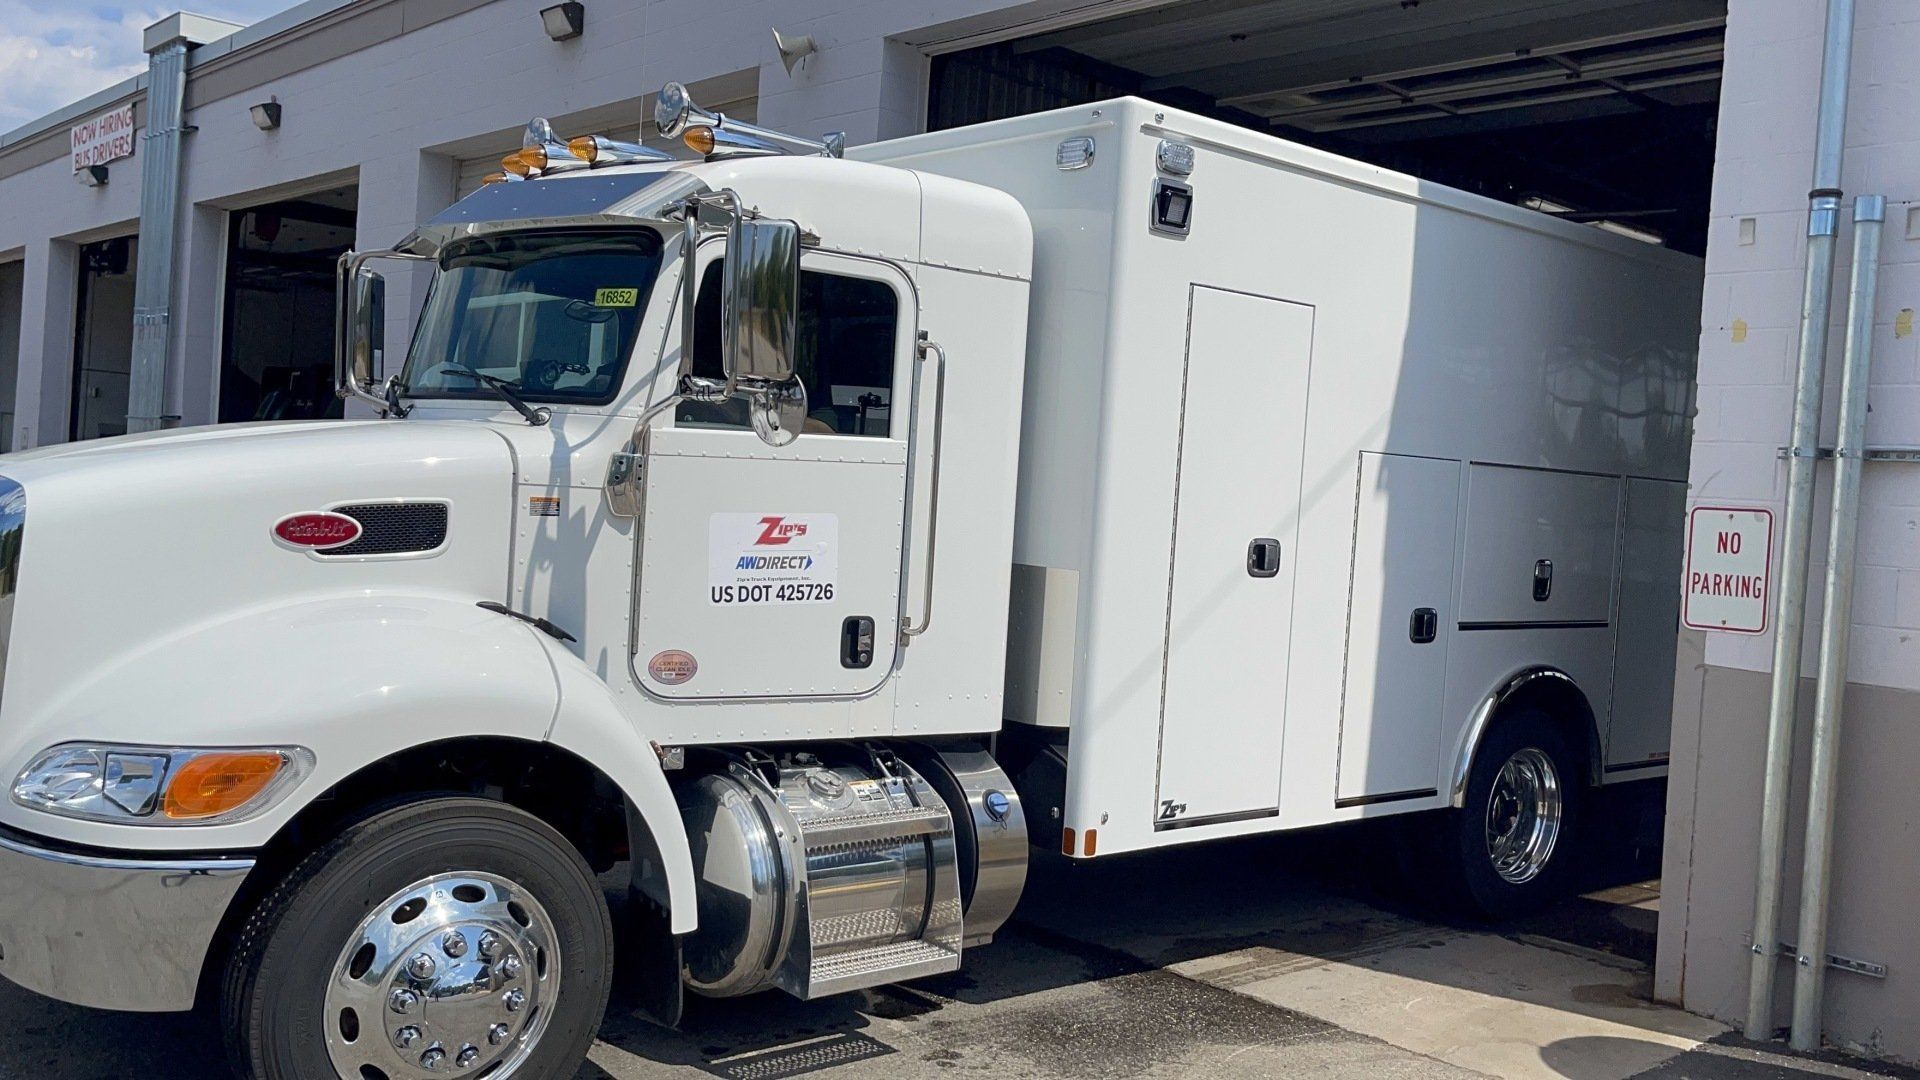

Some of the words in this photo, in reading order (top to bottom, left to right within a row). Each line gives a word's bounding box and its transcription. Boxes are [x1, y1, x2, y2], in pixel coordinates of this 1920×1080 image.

[73, 121, 98, 148] NOW
[99, 107, 133, 138] HIRING
[74, 148, 91, 169] BUS
[93, 134, 130, 164] DRIVERS
[600, 290, 632, 304] 16852
[285, 518, 351, 538] Peterbilt
[1717, 531, 1742, 554] NO
[735, 555, 807, 570] AWDIRECT
[711, 585, 734, 604] US
[738, 584, 773, 603] DOT
[775, 583, 834, 601] 425726
[1692, 572, 1762, 599] PARKING
